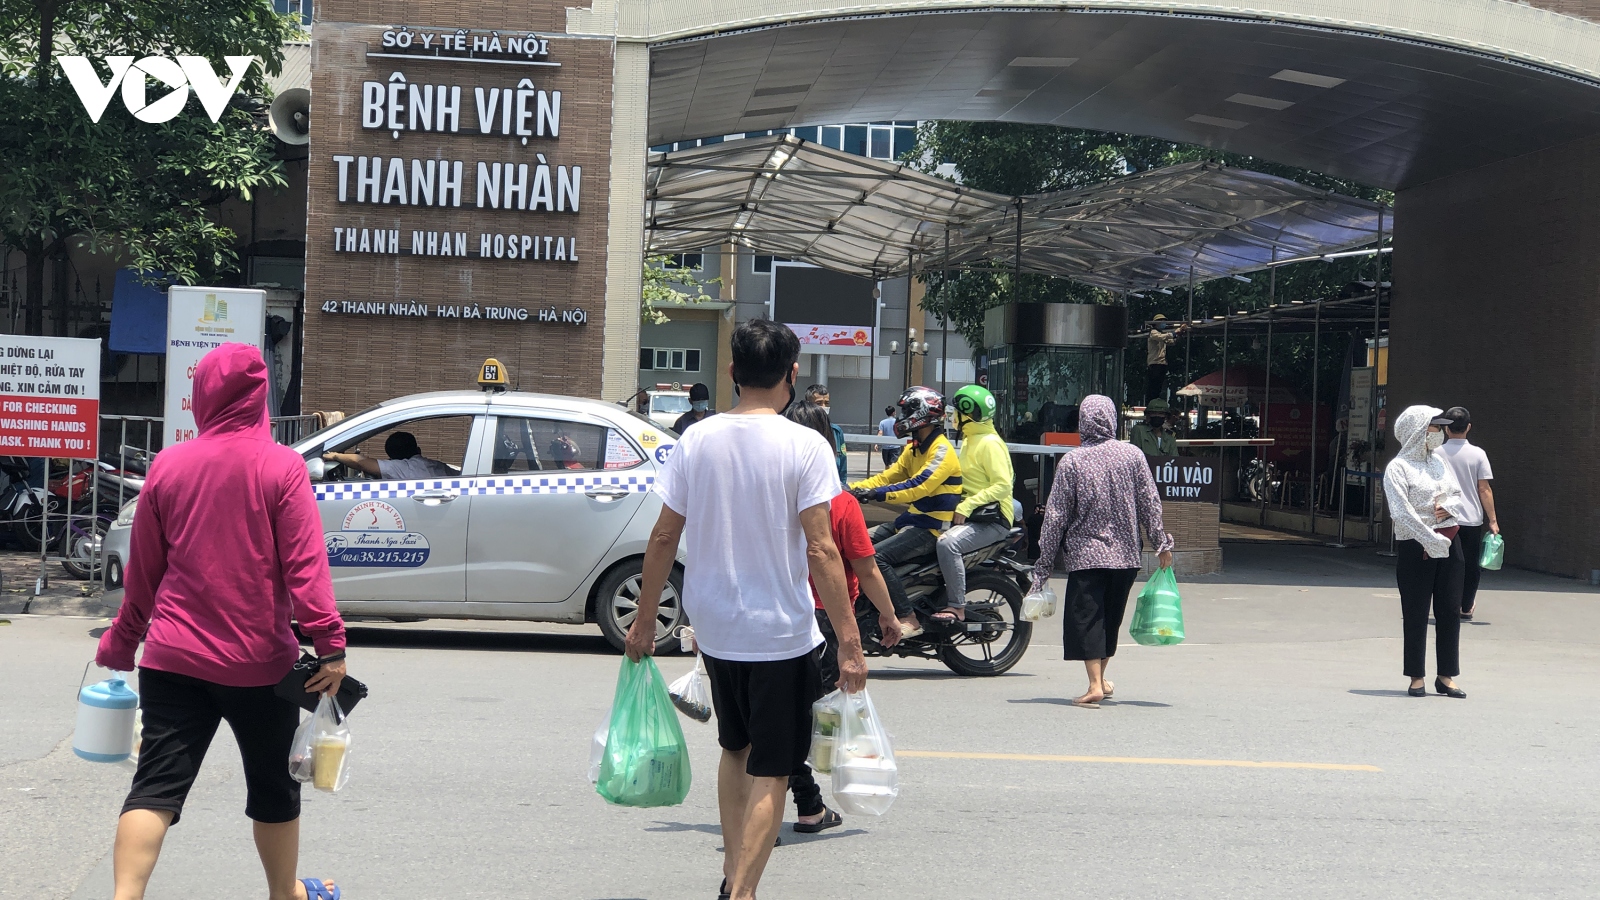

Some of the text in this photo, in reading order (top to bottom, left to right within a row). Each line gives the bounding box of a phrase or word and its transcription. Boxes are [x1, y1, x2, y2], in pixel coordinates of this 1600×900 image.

[382, 26, 548, 58] SỞ Y TẾ HÀ NỘI
[362, 71, 562, 145] BỆNH VIỆN
[332, 153, 582, 213] THANH NHÀN
[334, 227, 579, 262] THANH NHAN HOSPITAL
[321, 300, 587, 326] 42 THANH NHÀN HAI BÀ TRƯNG HÀ NỘI
[171, 340, 190, 348] BỆNH
[192, 340, 209, 349] VIỆN
[7, 346, 35, 359] DỪNG
[38, 348, 54, 361] LẠI
[25, 363, 42, 378] ĐỘ,
[45, 363, 65, 377] RỬA
[69, 367, 85, 378] TAY
[485, 365, 496, 373] EM
[485, 372, 496, 380] DI
[17, 382, 34, 393] XIN
[38, 380, 60, 394] CẢM
[64, 384, 78, 395] ƠN
[81, 385, 85, 395] !
[3, 401, 77, 415] FOR CHECKING
[0, 418, 86, 432] WASHING HANDS
[0, 435, 91, 450] ASK. THANK YOU !
[642, 433, 657, 442] be
[1156, 459, 1213, 484] LỐI VÀO
[1166, 485, 1201, 497] ENTRY
[376, 502, 394, 513] TAXI
[354, 533, 380, 545] Thanh
[381, 537, 398, 547] Nga
